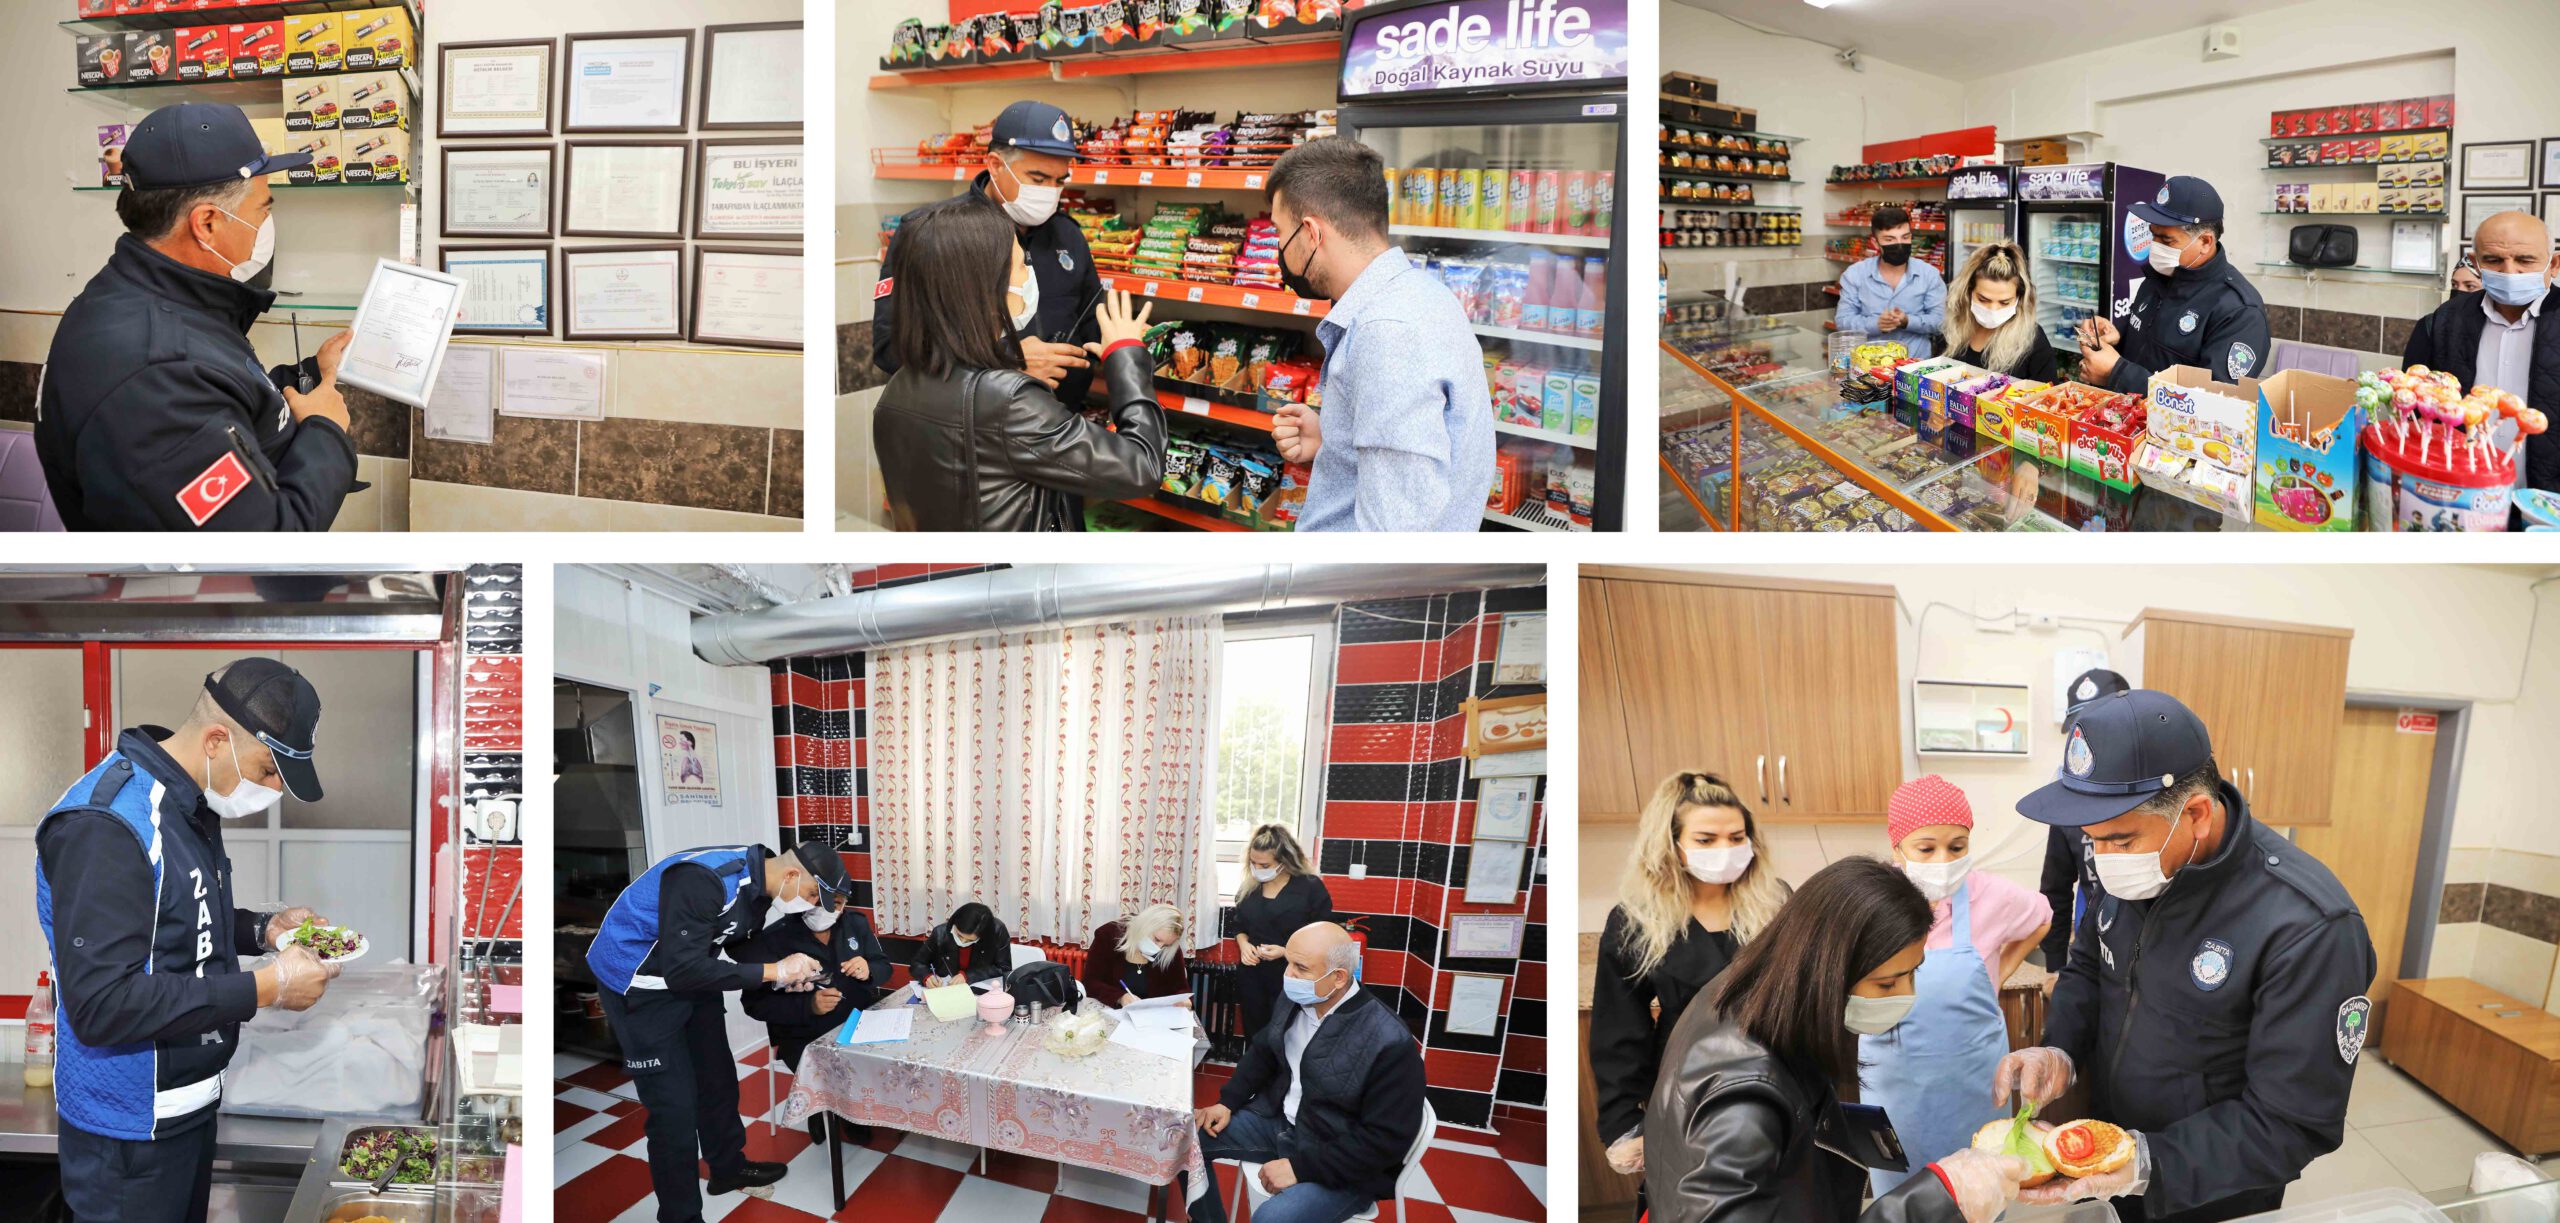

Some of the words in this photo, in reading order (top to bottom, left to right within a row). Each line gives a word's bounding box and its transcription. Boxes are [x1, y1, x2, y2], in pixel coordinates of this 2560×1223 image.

[1375, 6, 1492, 61] sade
[1505, 0, 1592, 50] life
[1434, 61, 1514, 83] Kaynak
[1522, 60, 1584, 79] Suyu
[1236, 127, 1267, 136] negro
[733, 160, 752, 169] BU
[755, 158, 798, 171] İŞYERİ
[1953, 172, 1977, 188] sade
[1979, 171, 1999, 187] life
[2028, 170, 2063, 187] sade
[2065, 168, 2089, 186] life
[1896, 380, 1912, 392] FALIM
[1920, 388, 1940, 400] FALIM
[1949, 399, 1969, 414] FALIM
[2156, 387, 2195, 414] Bonart
[2020, 416, 2037, 431] ekşi
[2045, 424, 2060, 442] yüz
[2077, 434, 2098, 450] ekşi
[2106, 443, 2126, 464] yüz
[2204, 940, 2230, 957] ZABITA
[626, 1058, 662, 1069] ZABITA
